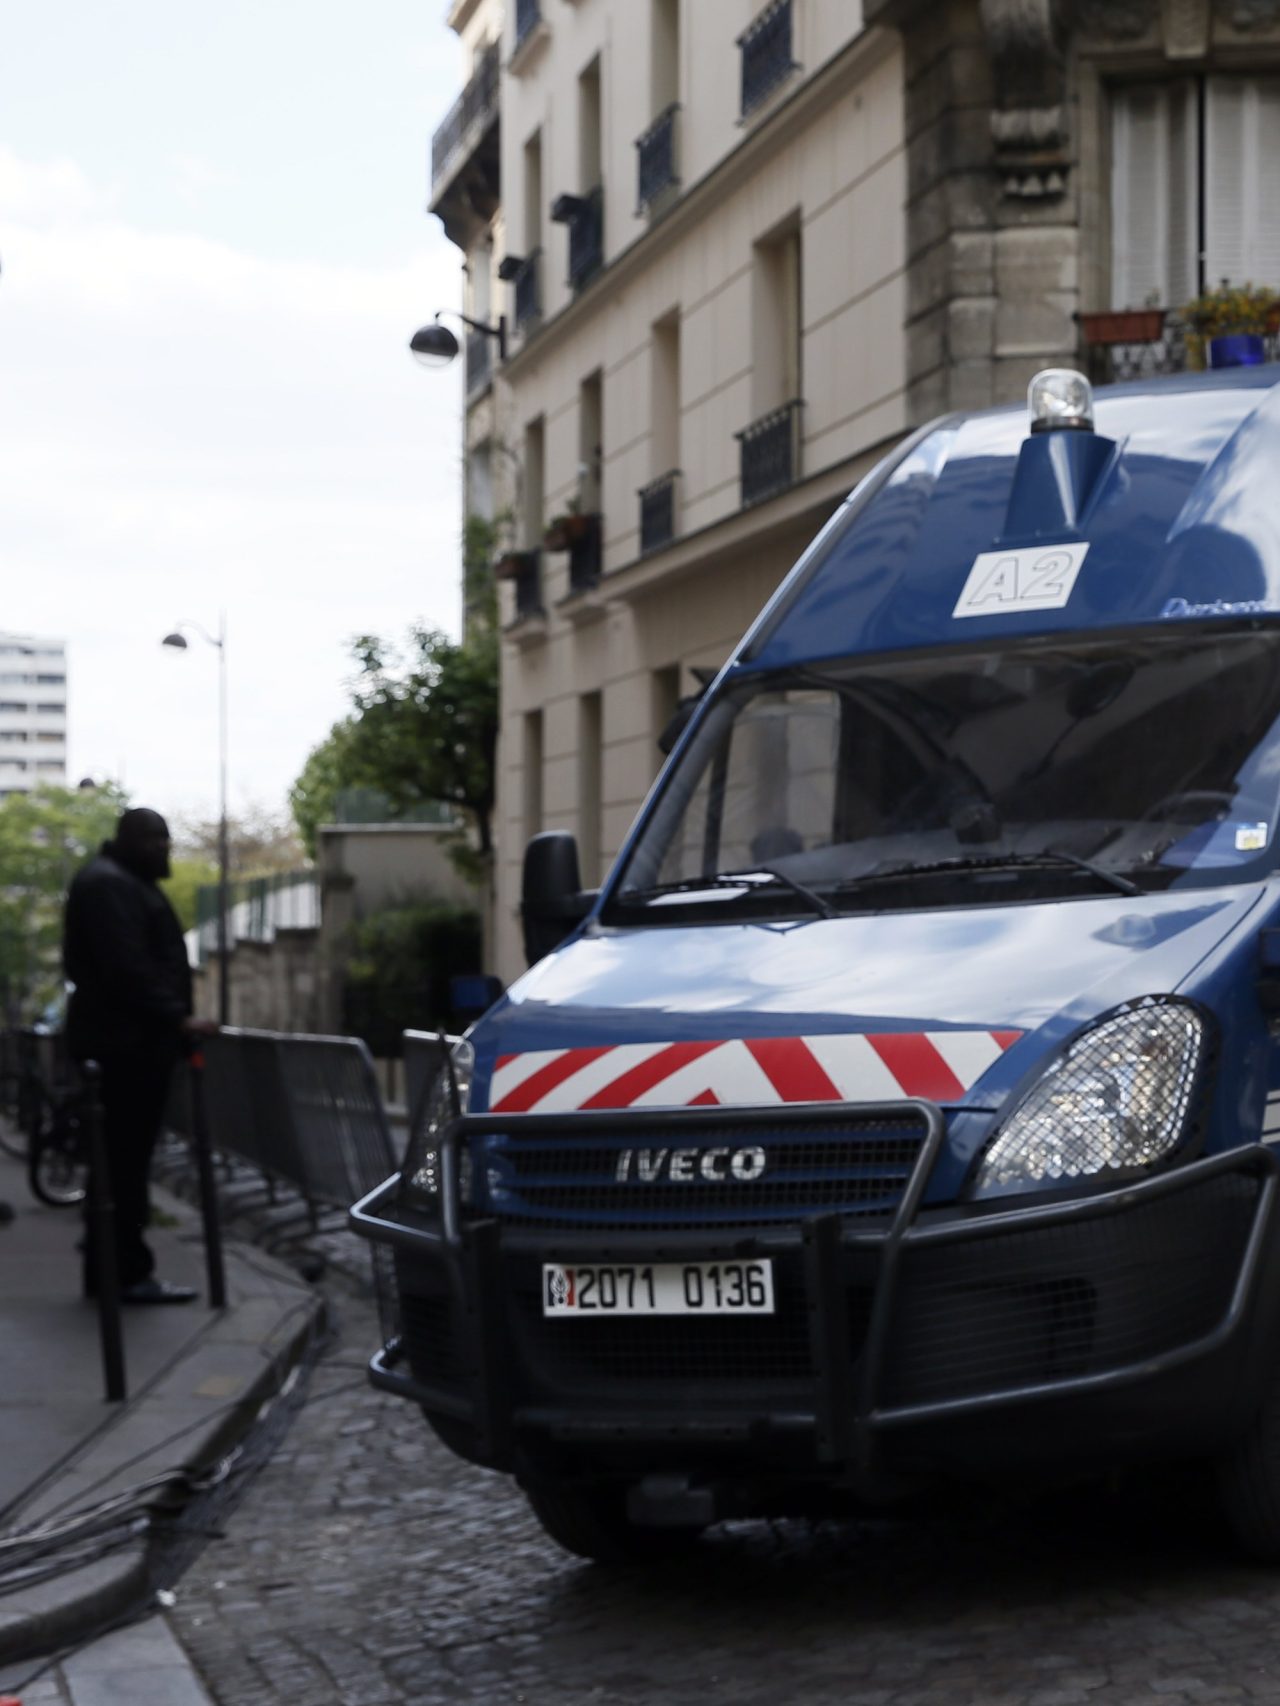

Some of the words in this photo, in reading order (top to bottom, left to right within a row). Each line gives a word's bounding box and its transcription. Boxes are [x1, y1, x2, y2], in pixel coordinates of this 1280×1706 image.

[966, 550, 1074, 606] A2
[615, 1146, 766, 1182] IVECO
[577, 1268, 656, 1309] 2071
[682, 1265, 767, 1307] 0136
